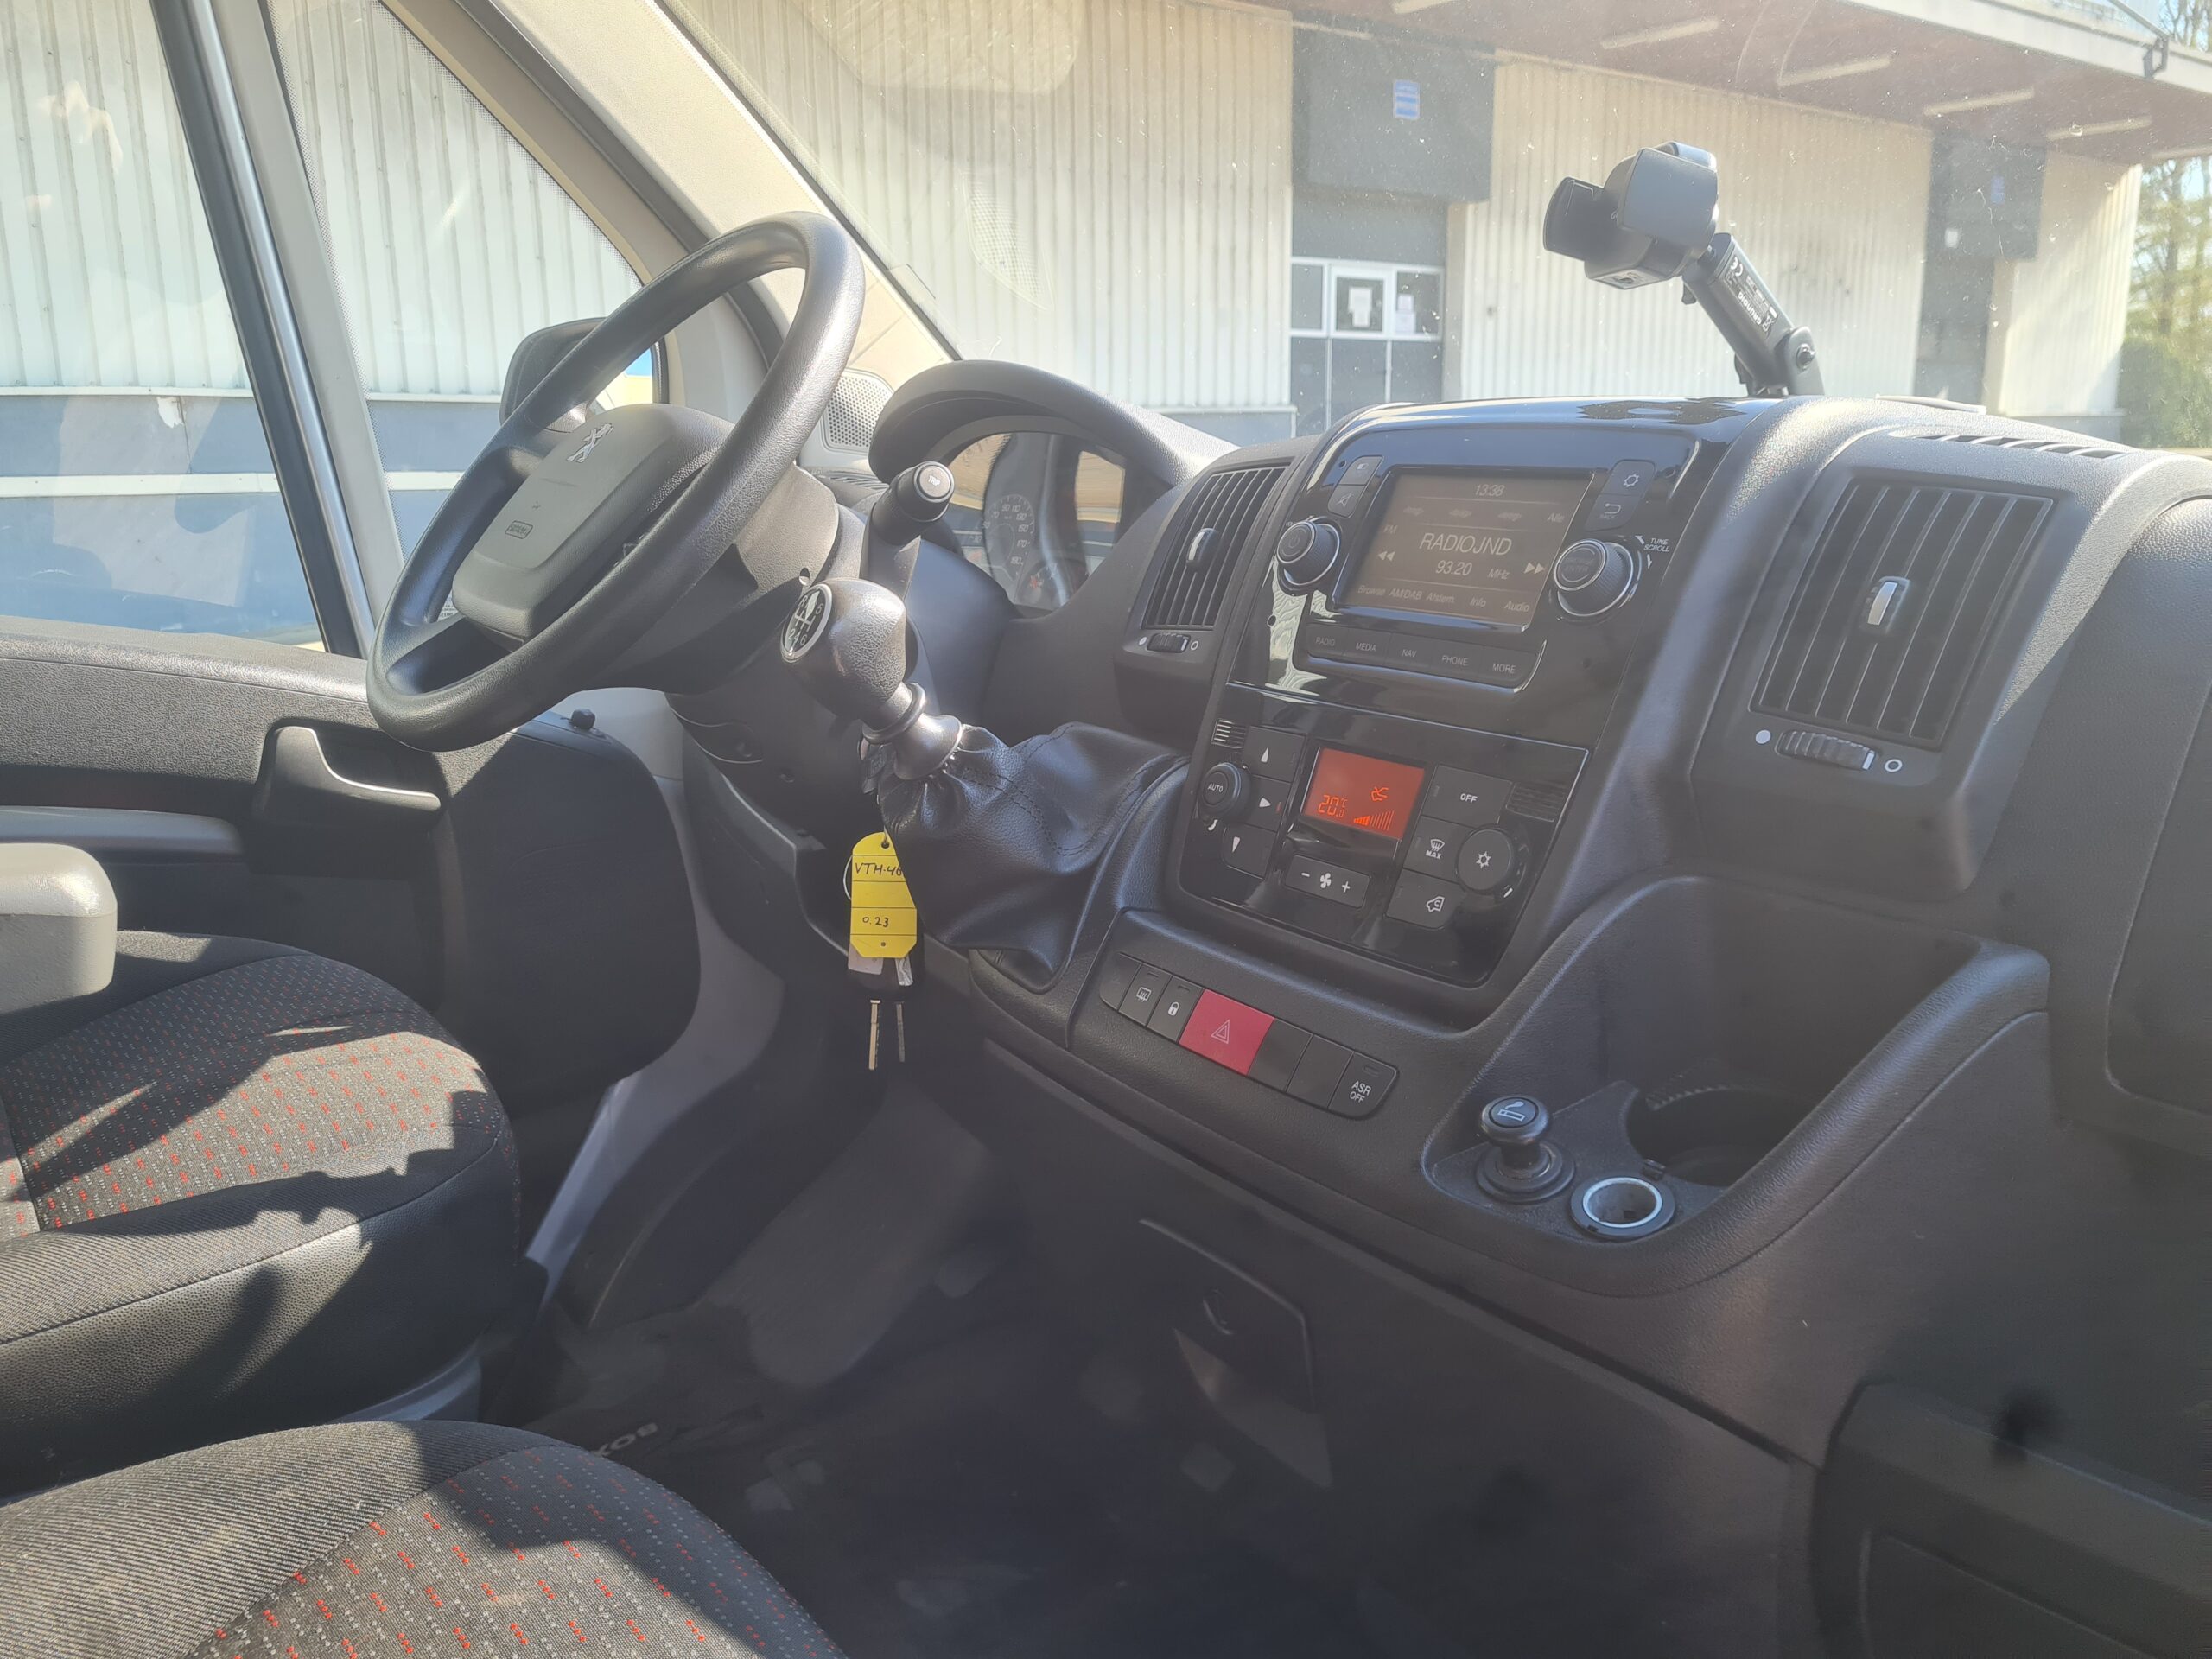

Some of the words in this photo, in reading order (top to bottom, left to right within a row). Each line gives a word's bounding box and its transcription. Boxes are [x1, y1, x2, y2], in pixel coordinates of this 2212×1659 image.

[1738, 291, 1762, 325] GRUNDIG
[1475, 484, 1505, 497] 13:38
[1383, 524, 1398, 534] FM
[1435, 559, 1473, 576] 93.20
[1487, 568, 1510, 580] MHz
[798, 594, 808, 607] R
[1469, 597, 1486, 607] Info
[1503, 601, 1530, 613] Audio
[815, 603, 823, 614] 5
[788, 628, 796, 640] 2
[800, 634, 808, 645] 6
[1315, 636, 1335, 647] RADIO
[1355, 642, 1376, 652] MEDIA
[1402, 649, 1417, 658] NAV
[1441, 655, 1469, 667] PHONE
[1492, 662, 1516, 674] MORE
[1207, 783, 1224, 793] AUTO
[1459, 793, 1478, 803] OFF
[1426, 849, 1442, 860] MAX
[1351, 1080, 1371, 1096] ASR
[1350, 1090, 1365, 1103] OFF
